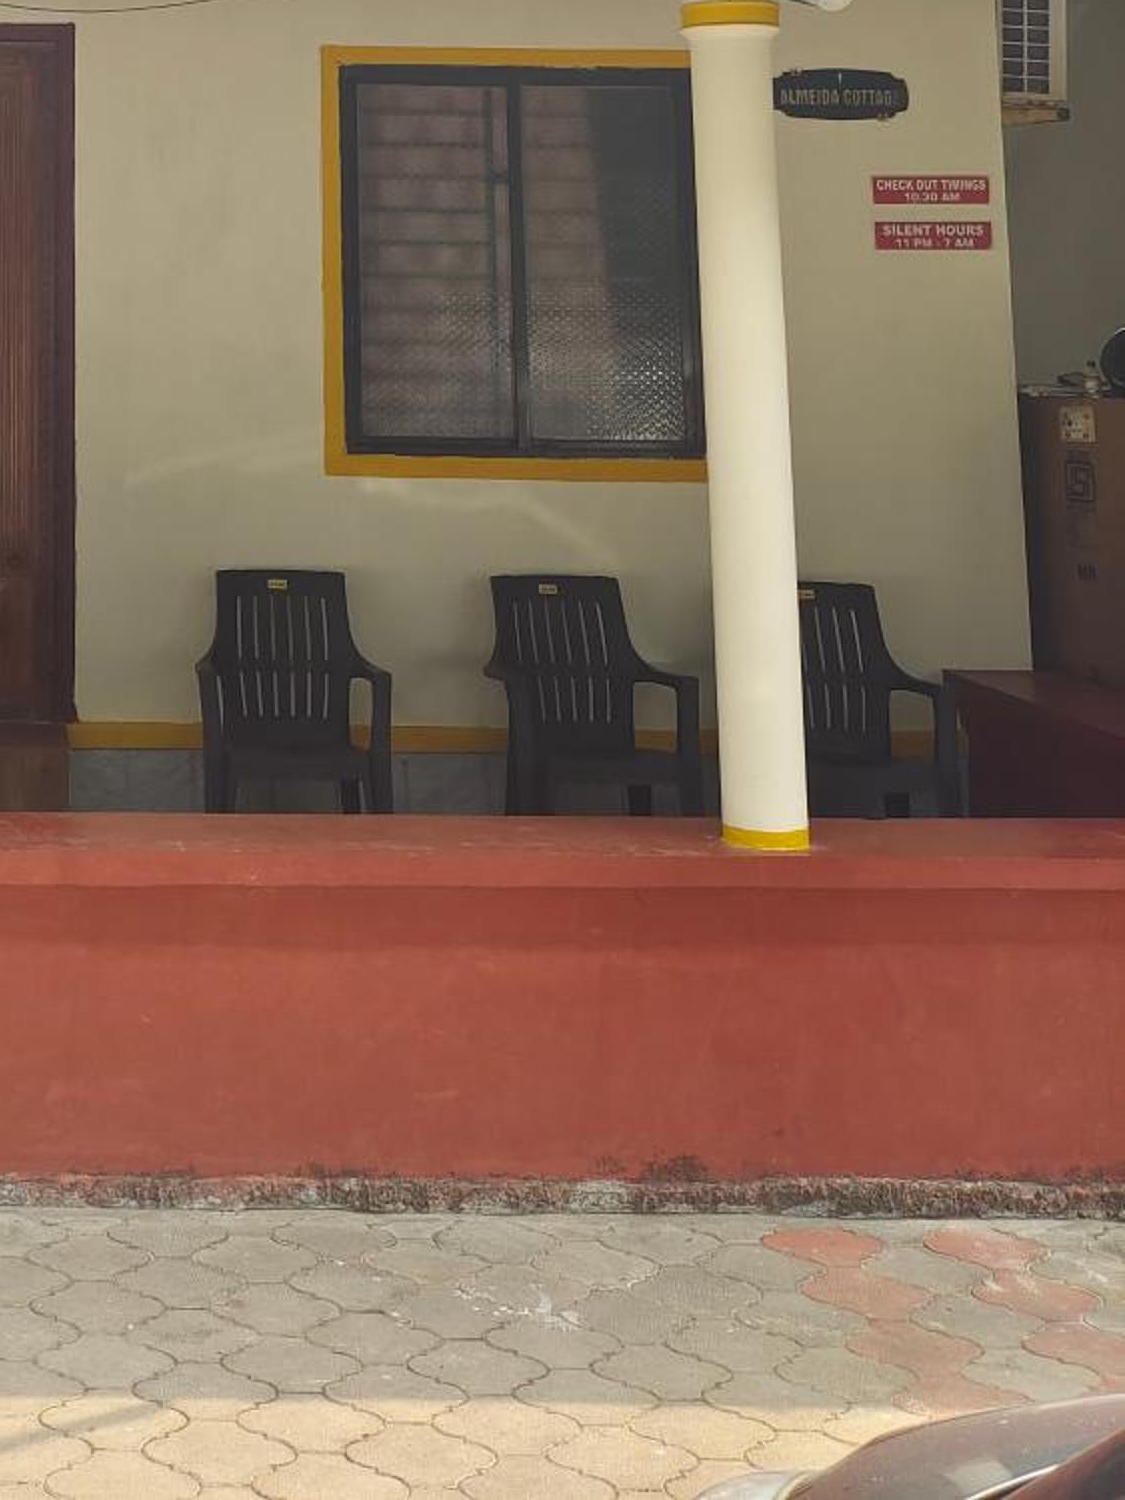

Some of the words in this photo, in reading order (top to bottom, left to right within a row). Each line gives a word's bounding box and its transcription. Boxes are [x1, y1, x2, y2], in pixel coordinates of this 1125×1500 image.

[876, 179, 914, 191] CHECK
[916, 179, 938, 191] OUT
[941, 179, 986, 191] TIMINGS
[942, 192, 961, 202] AM
[882, 224, 932, 236] SILENT
[936, 224, 984, 236] HOURS
[914, 238, 932, 248] PM
